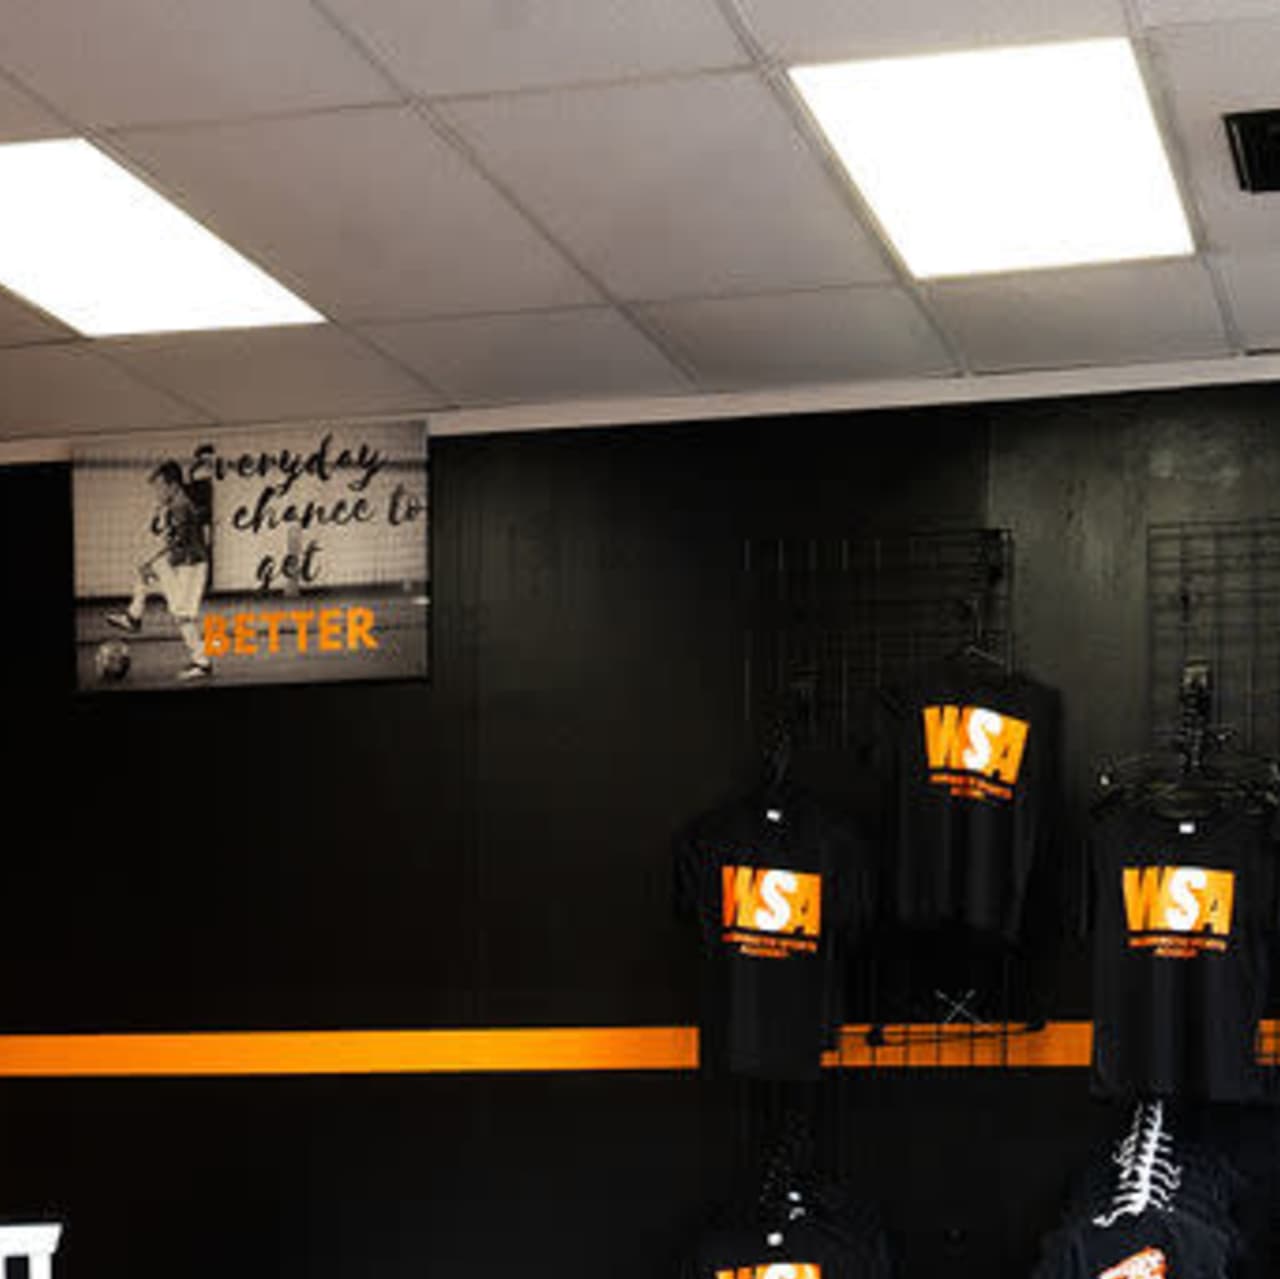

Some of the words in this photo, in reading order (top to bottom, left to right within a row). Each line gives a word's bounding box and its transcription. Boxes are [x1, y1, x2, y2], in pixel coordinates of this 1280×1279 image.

[189, 431, 387, 496] Everyday
[233, 486, 376, 534] chance
[388, 482, 428, 526] to
[256, 540, 324, 591] get
[203, 606, 379, 657] BETTER
[923, 704, 1031, 785] WSA
[721, 865, 823, 937] WSA
[1122, 865, 1236, 936] WSA
